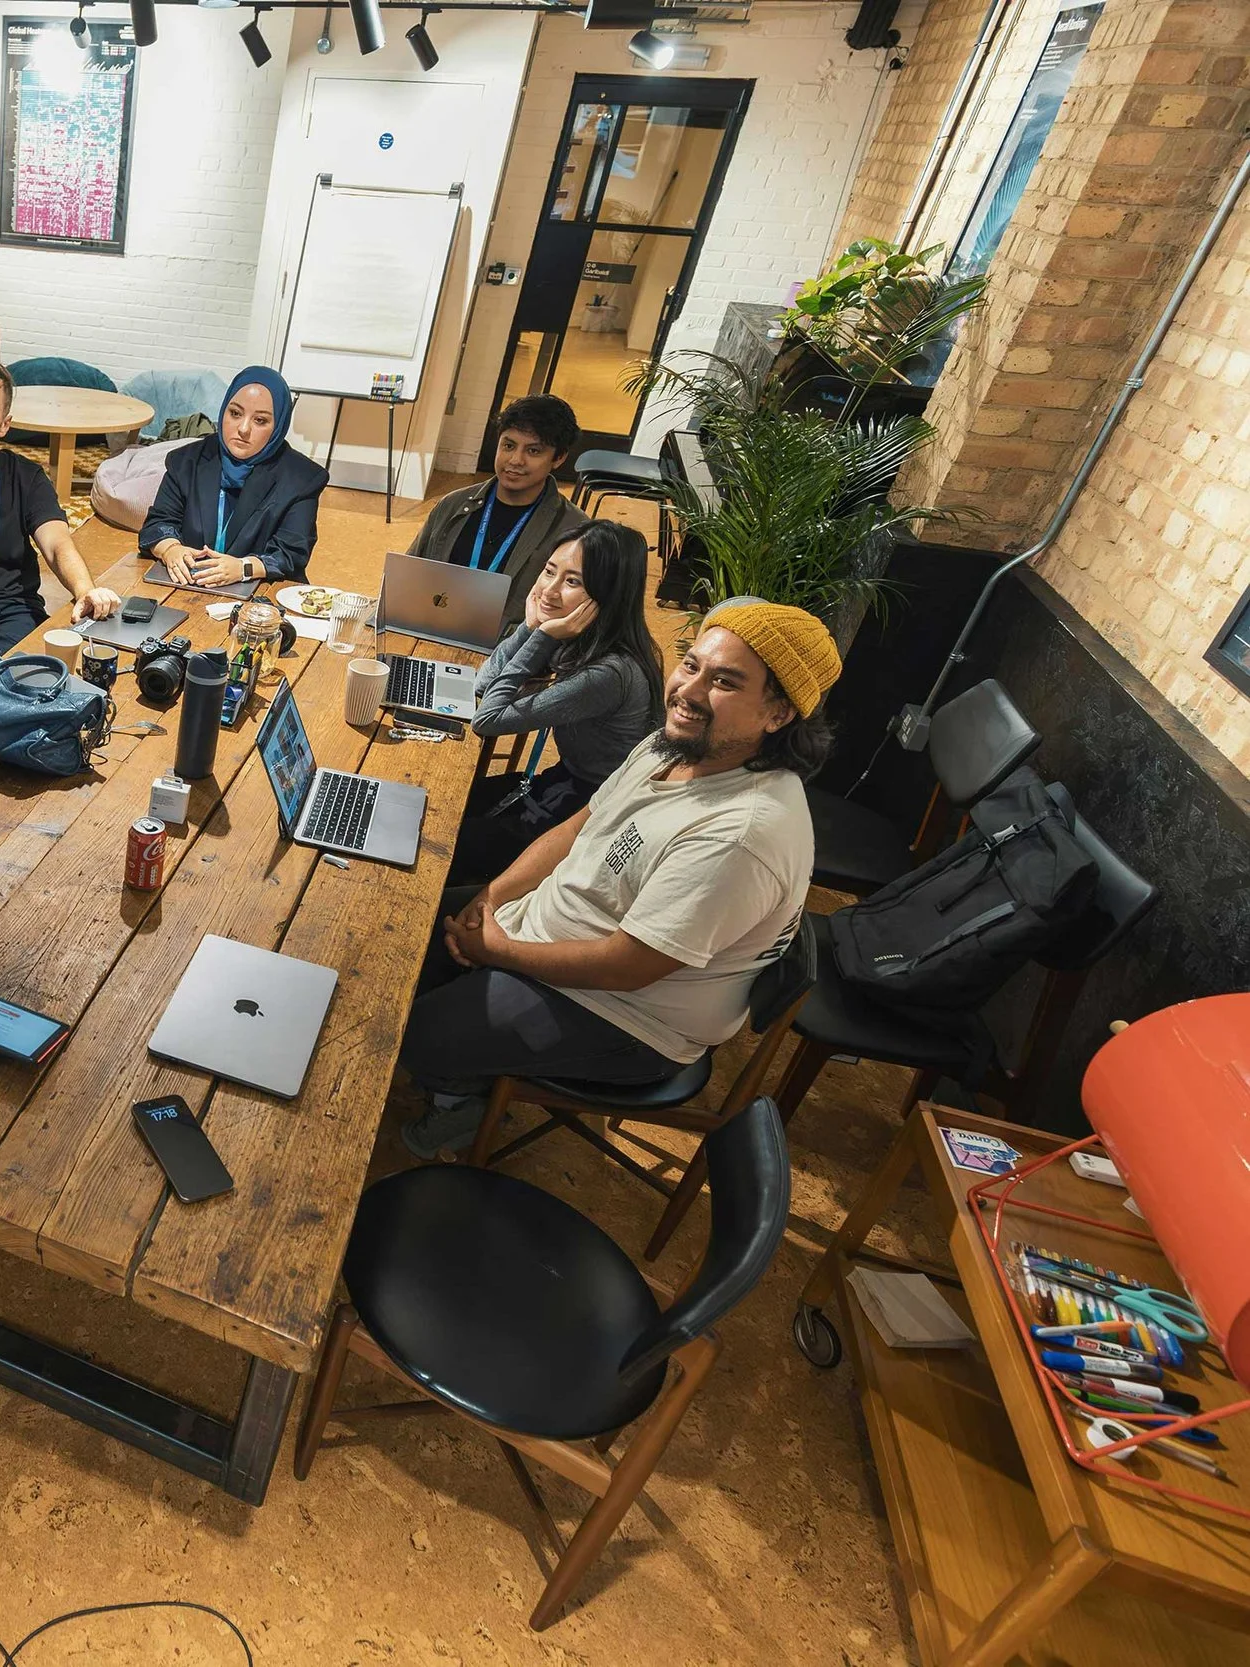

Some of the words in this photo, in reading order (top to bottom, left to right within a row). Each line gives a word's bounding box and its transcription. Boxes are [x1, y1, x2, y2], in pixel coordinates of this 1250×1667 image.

[8, 26, 26, 35] Global
[150, 1108, 178, 1122] 17:18
[957, 1131, 1001, 1149] Canva
